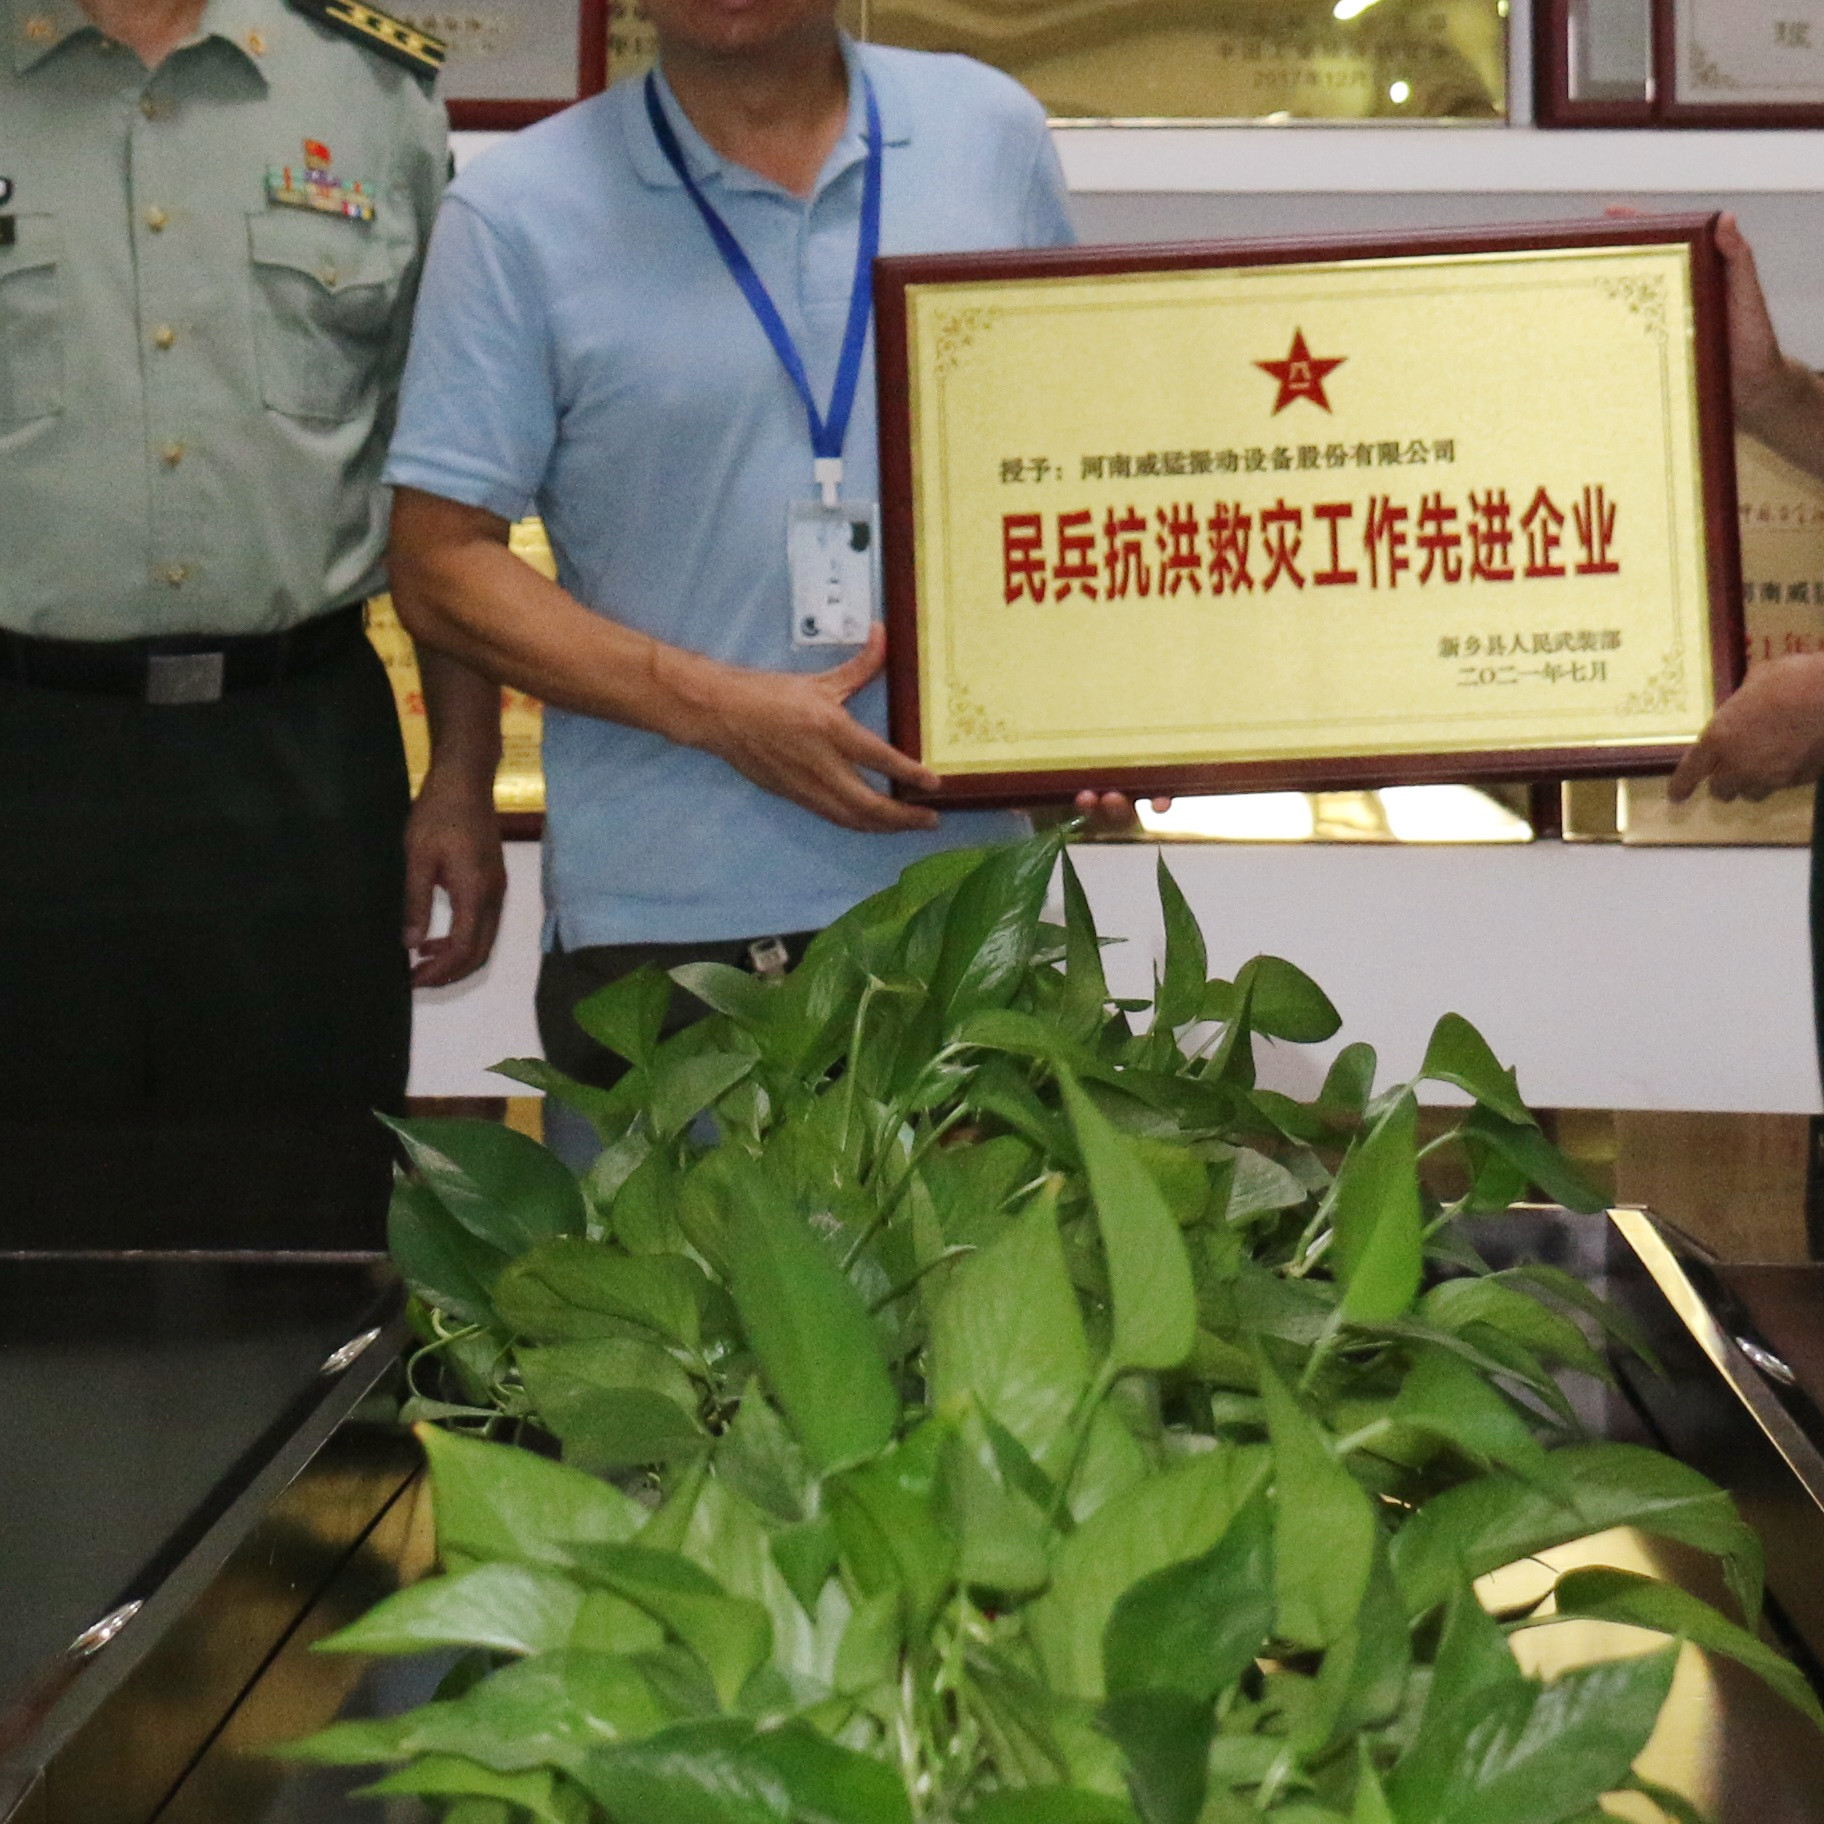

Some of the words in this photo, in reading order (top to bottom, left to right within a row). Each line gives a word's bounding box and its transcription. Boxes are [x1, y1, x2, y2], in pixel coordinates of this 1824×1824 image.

[1001, 484, 1620, 606] 民兵抗洪救灾工作先进企业
[1438, 629, 1623, 658] 新乡县人民武装部
